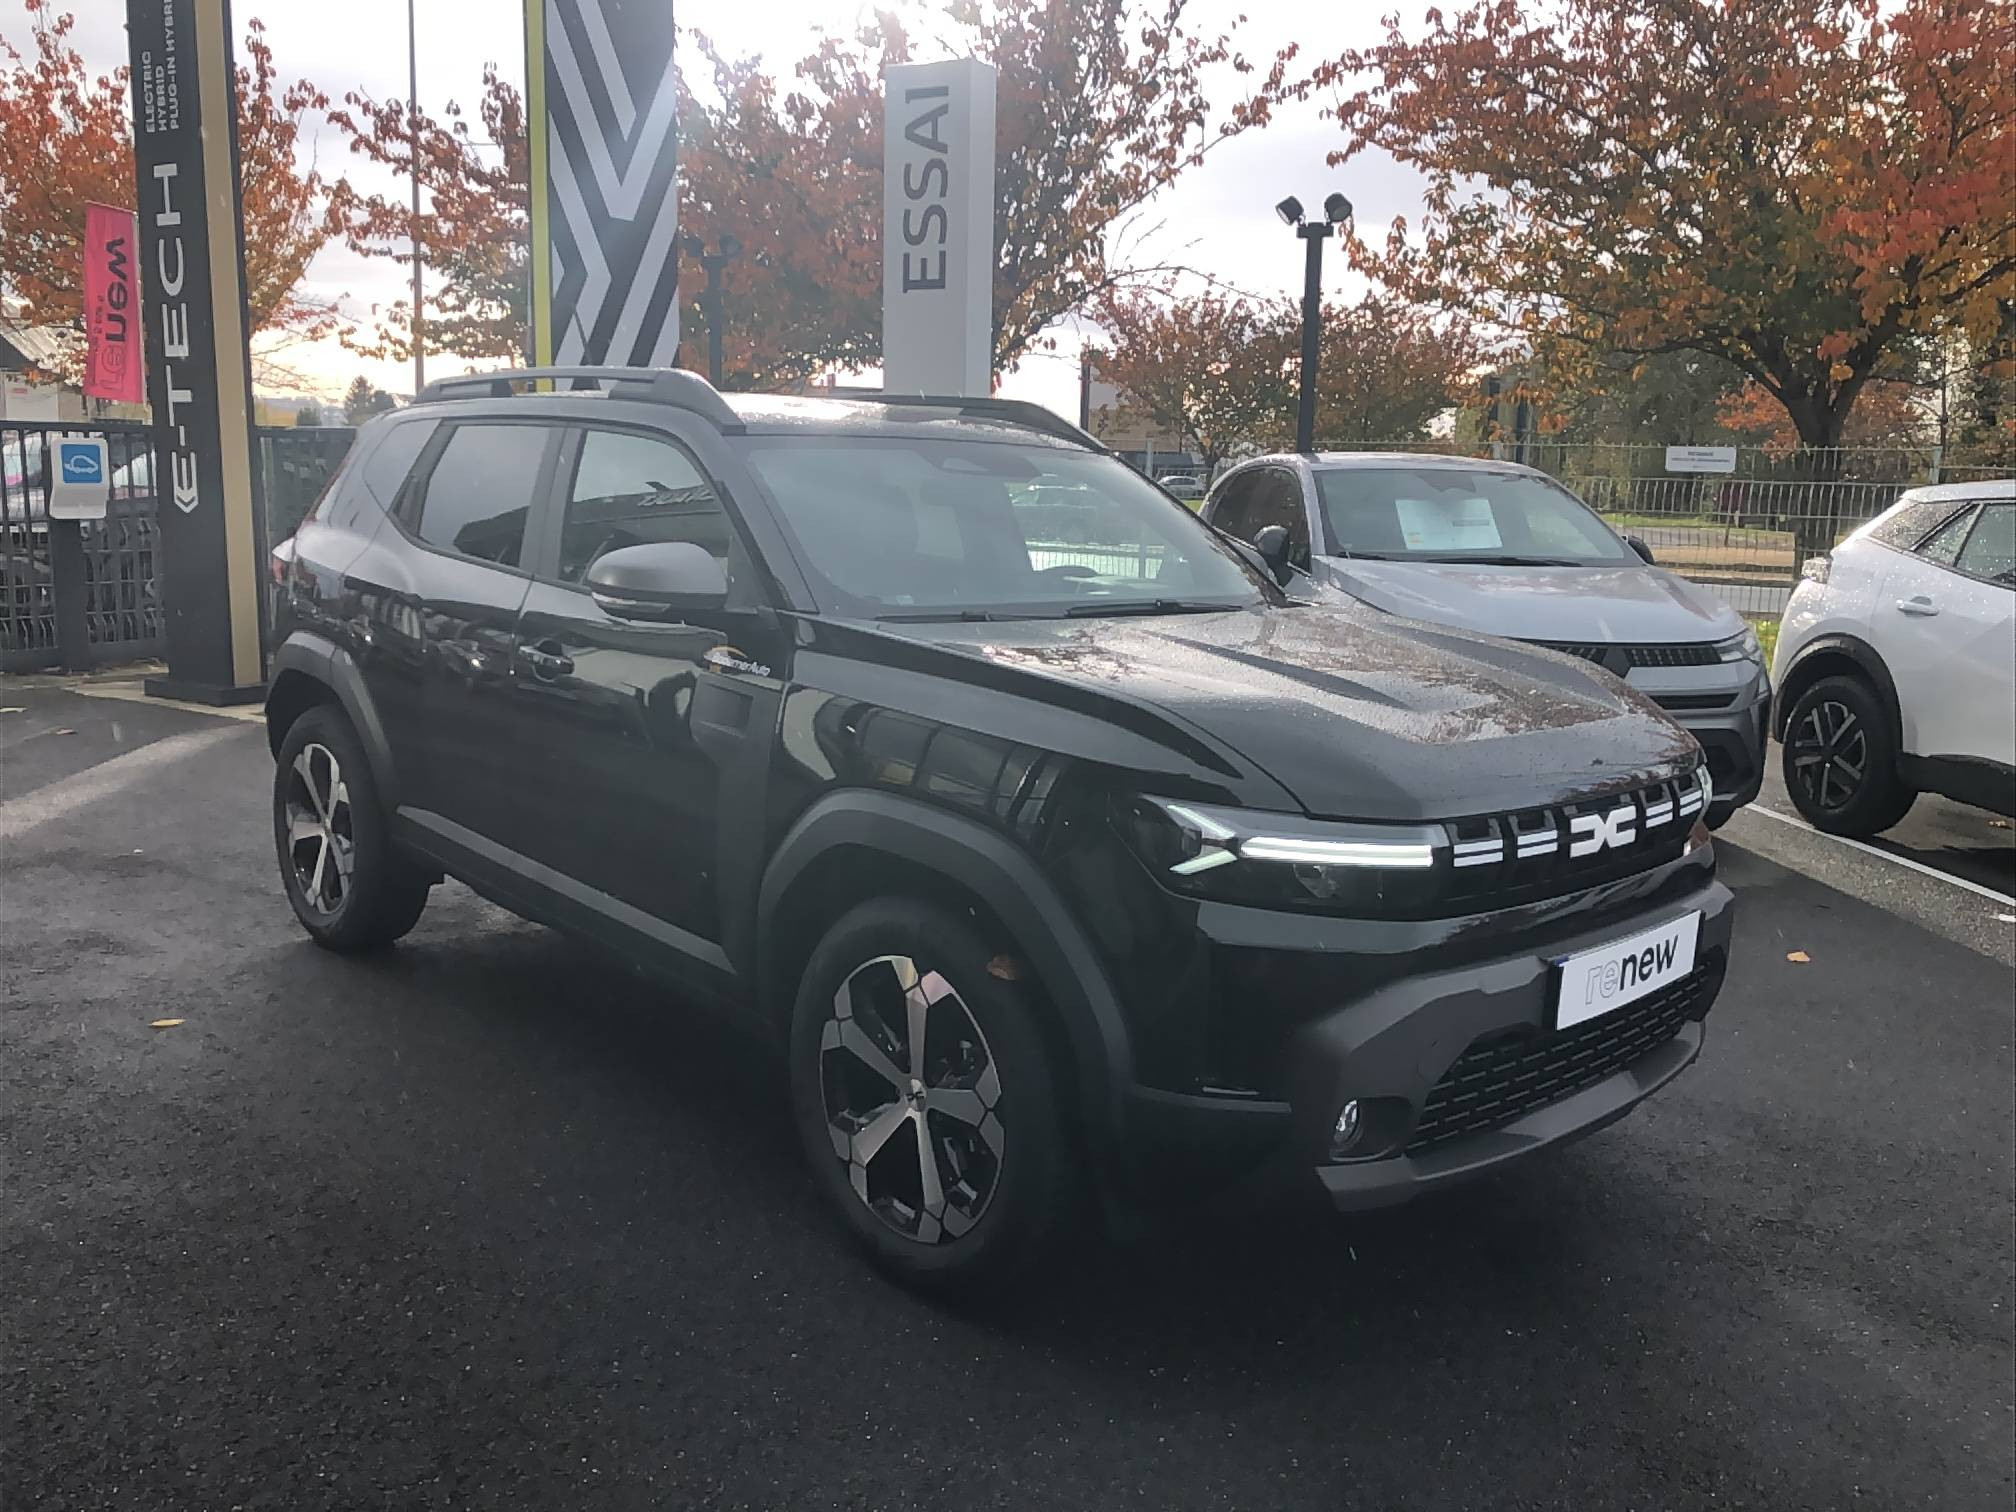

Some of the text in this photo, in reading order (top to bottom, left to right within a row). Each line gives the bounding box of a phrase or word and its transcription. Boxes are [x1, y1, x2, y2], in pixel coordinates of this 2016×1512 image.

[142, 51, 155, 133] ELECTRIC
[155, 65, 167, 131] HYBRID
[163, 0, 179, 129] PLUG-IN HYBRI
[902, 85, 949, 294] ESSAI
[153, 163, 199, 513] E-TECH
[1585, 934, 1679, 1005] renew
